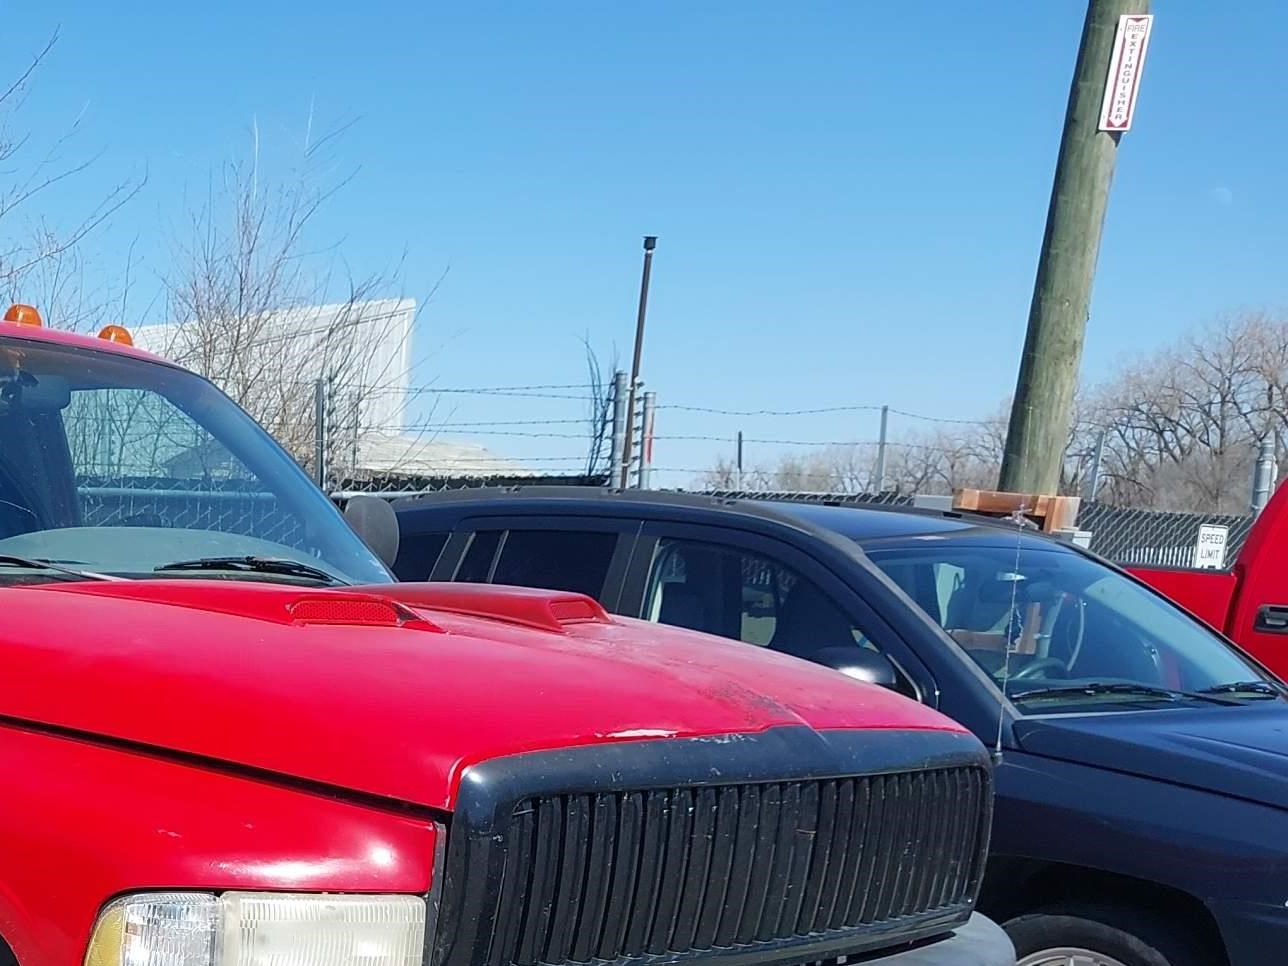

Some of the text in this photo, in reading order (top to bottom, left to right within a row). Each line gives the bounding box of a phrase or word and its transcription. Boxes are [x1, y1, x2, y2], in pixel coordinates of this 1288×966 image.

[1127, 24, 1146, 32] FIRE
[1115, 33, 1138, 120] EXTINGUISHER
[1201, 533, 1224, 545] SPEED
[1200, 548, 1220, 559] LIMIT
